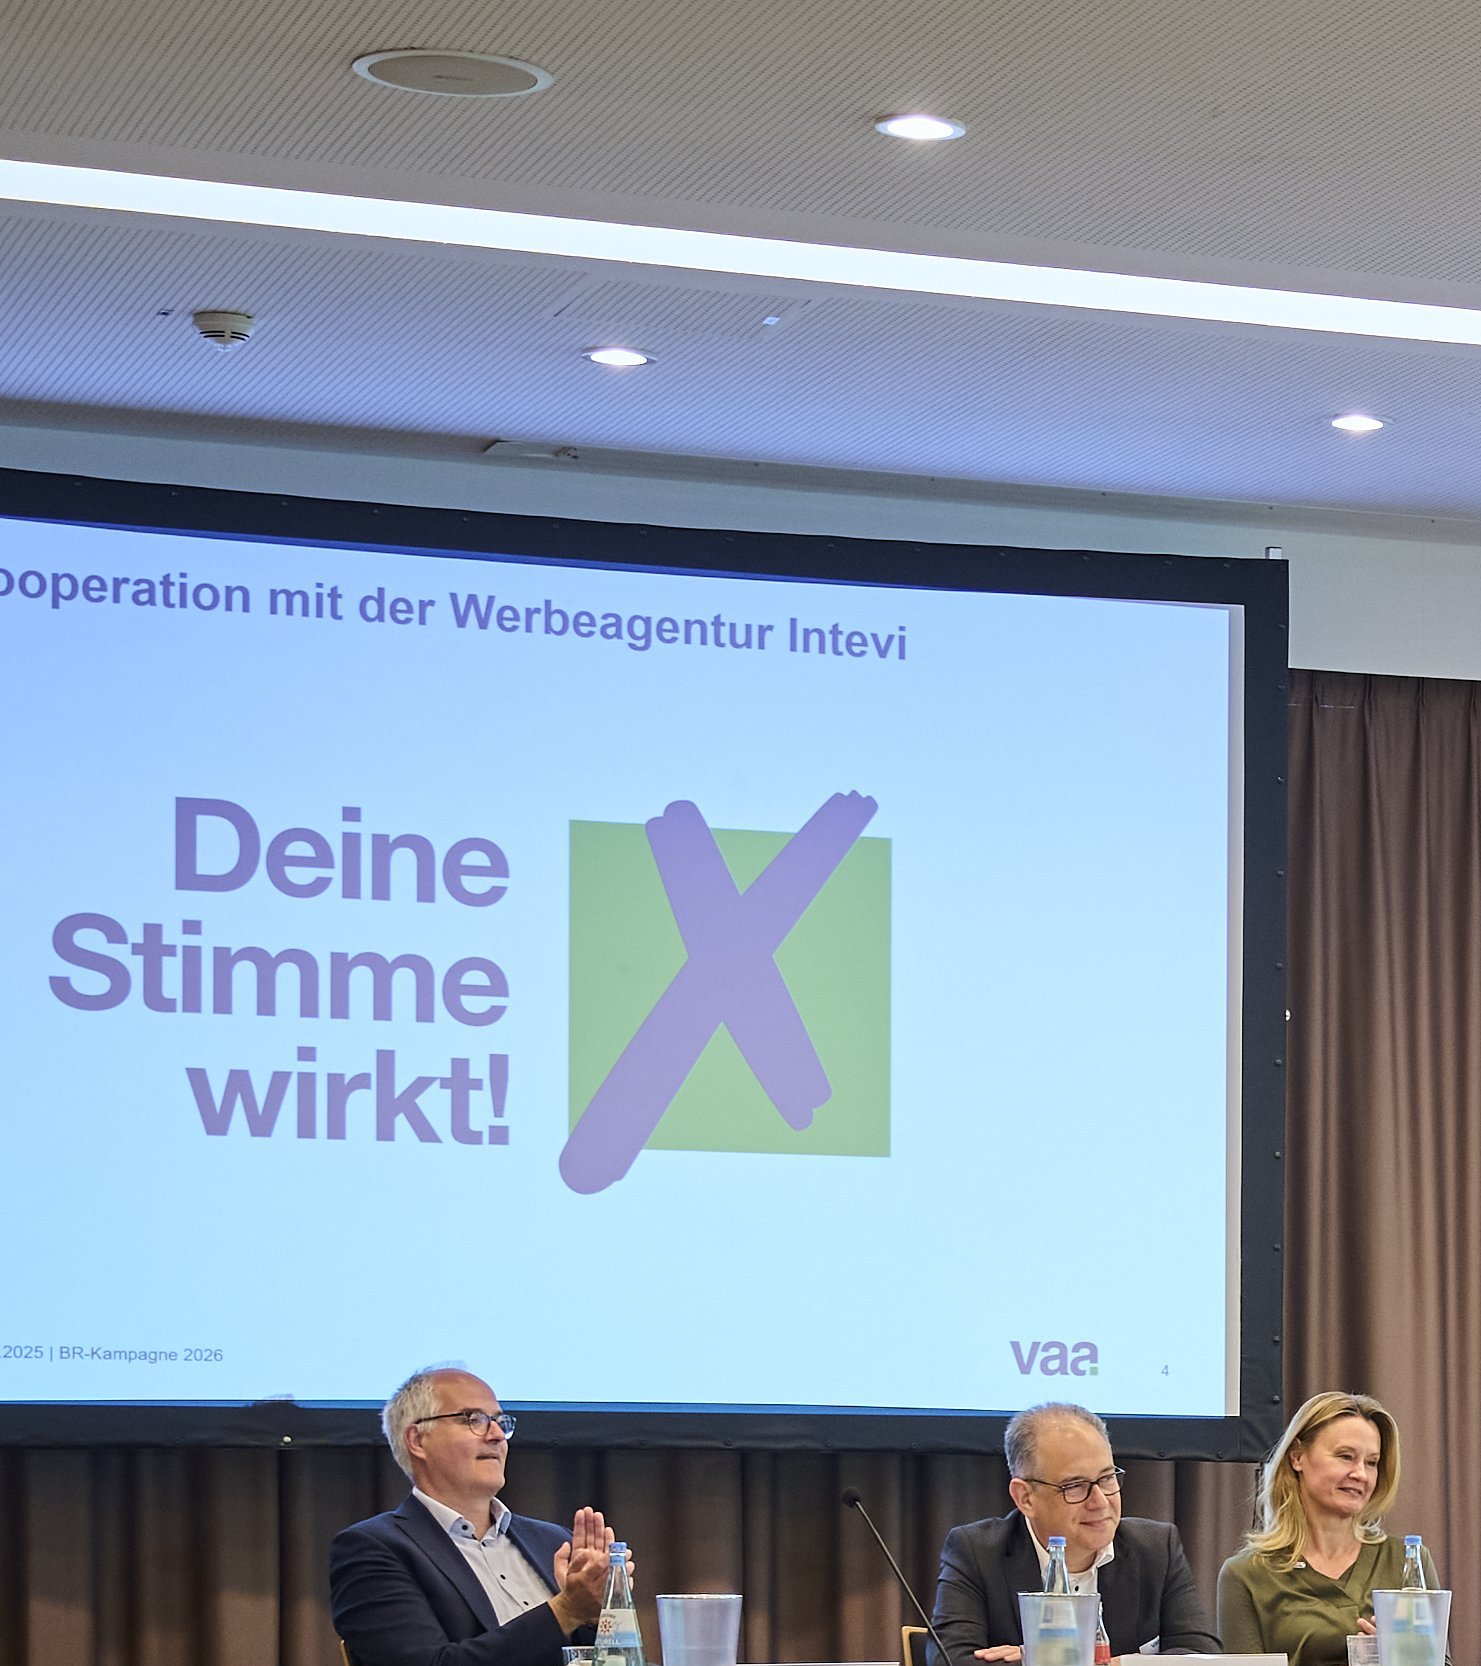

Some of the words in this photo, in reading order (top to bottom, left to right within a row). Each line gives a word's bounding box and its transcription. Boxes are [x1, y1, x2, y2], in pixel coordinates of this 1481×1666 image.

[269, 582, 343, 620] mit
[359, 587, 435, 625] der
[449, 592, 774, 652] Werbeagentur
[789, 618, 906, 661] Intevi
[175, 797, 510, 907] Deine
[48, 911, 510, 1026] Stimme
[185, 1046, 510, 1146] wirkt!
[60, 1346, 178, 1364] BR-Kampagne
[183, 1348, 224, 1361] 2026
[1010, 1341, 1098, 1376] vaa
[1161, 1365, 1169, 1376] 4
